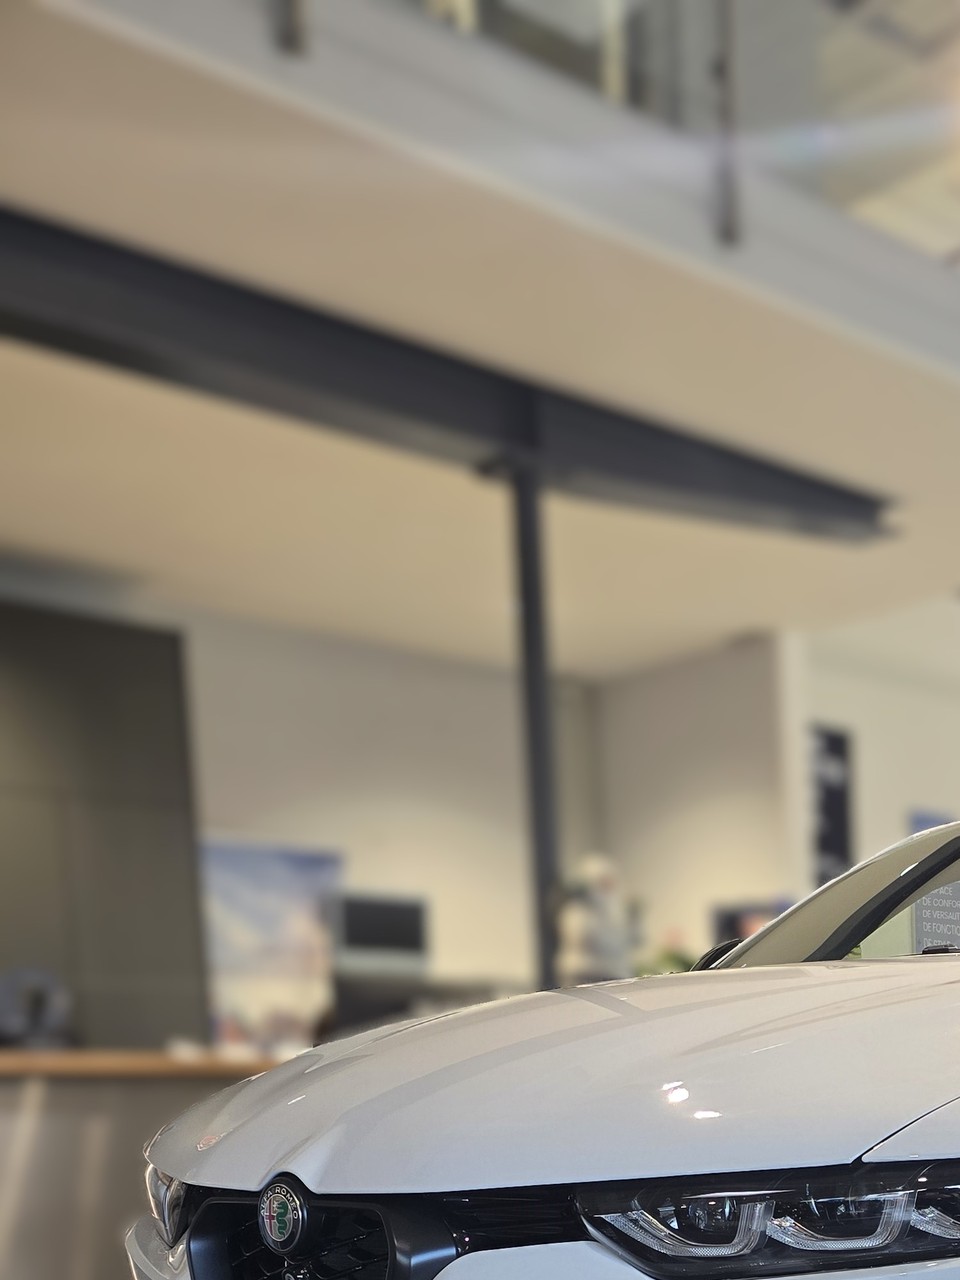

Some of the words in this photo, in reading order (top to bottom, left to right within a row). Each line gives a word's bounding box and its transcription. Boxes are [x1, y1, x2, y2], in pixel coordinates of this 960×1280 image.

[922, 898, 931, 906] DE
[922, 910, 932, 919] DE
[923, 922, 932, 932] DE
[275, 1186, 299, 1219] ROMEO
